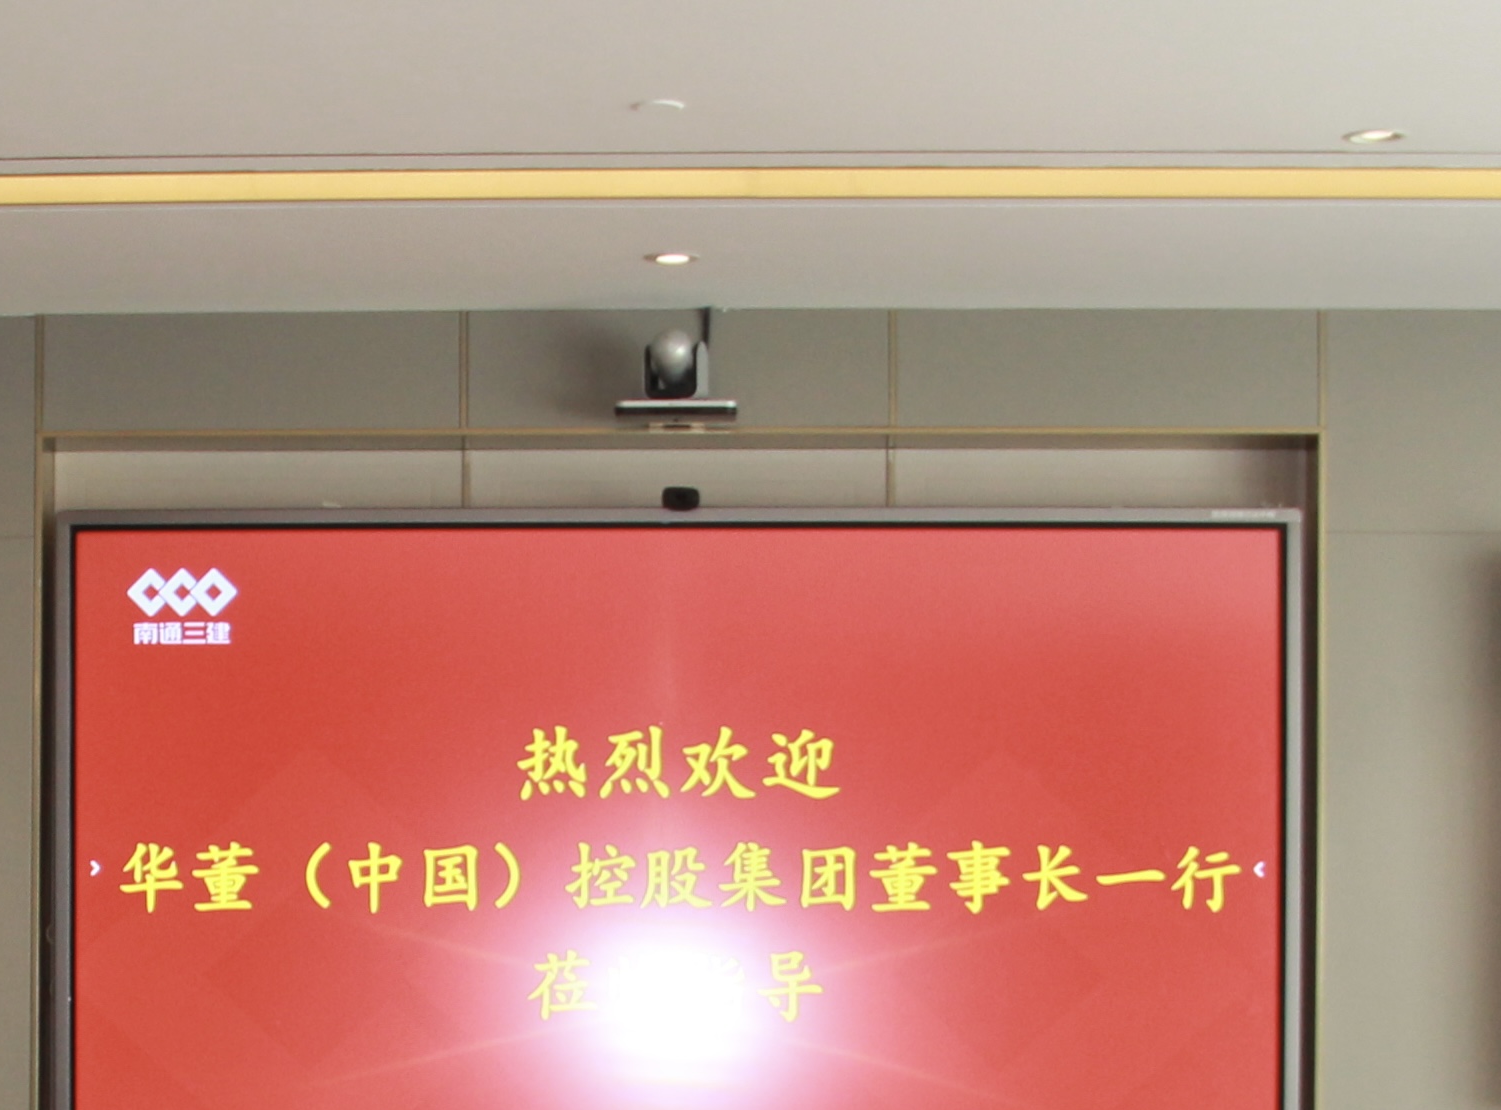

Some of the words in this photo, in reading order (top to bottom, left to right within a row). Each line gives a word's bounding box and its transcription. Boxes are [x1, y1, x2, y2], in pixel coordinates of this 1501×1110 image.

[133, 622, 231, 645] 南通三建
[516, 725, 841, 801] 热烈欢迎
[119, 839, 1242, 915] 华董（中国）控股集团董事长一行
[527, 949, 824, 1022] 莅导
